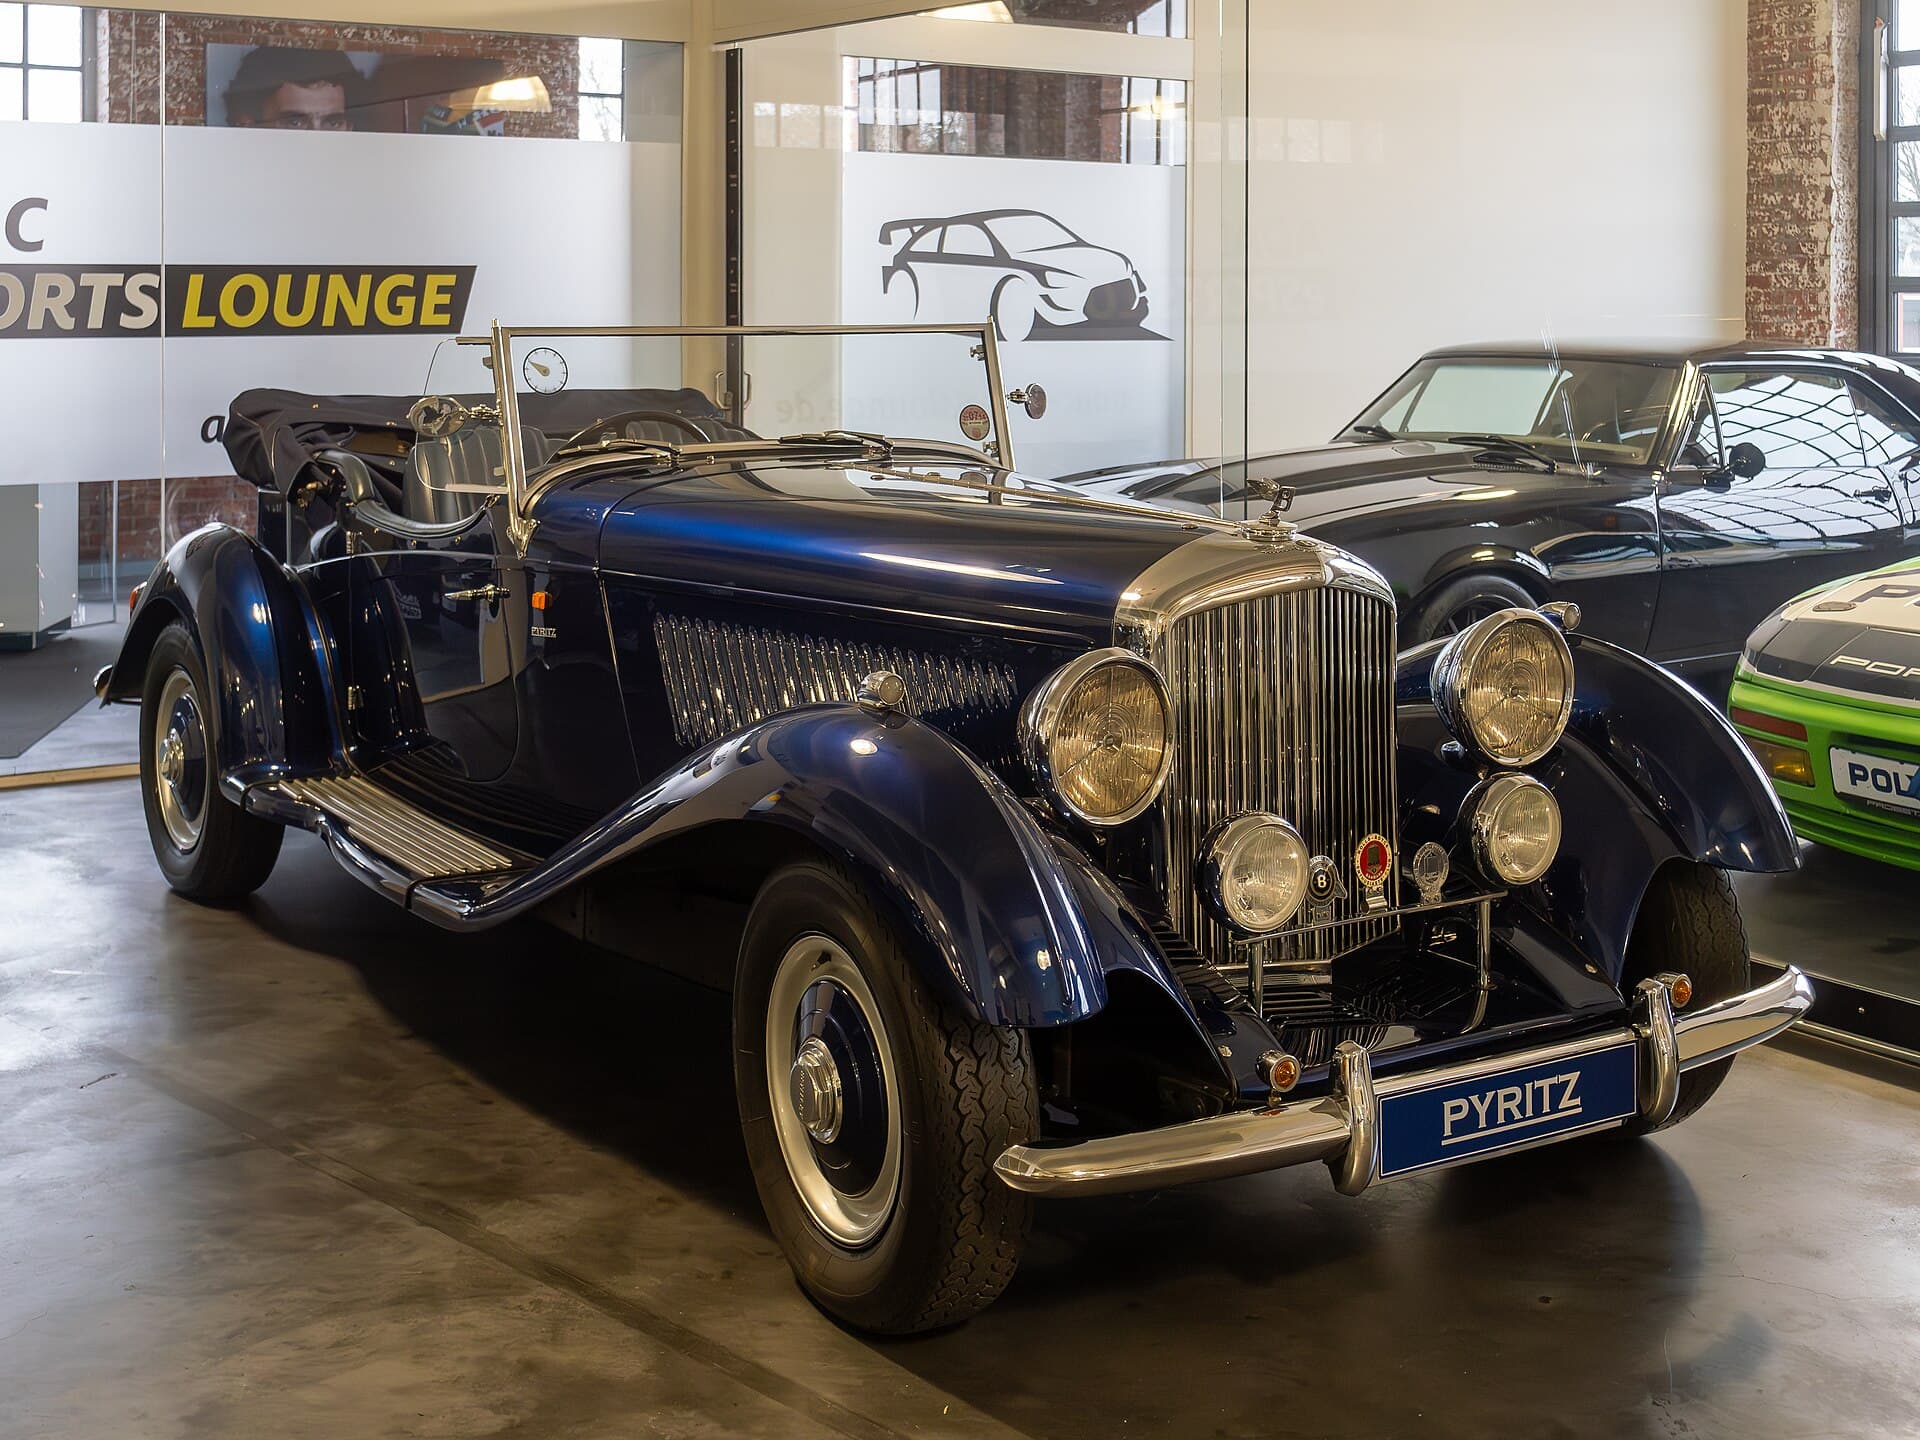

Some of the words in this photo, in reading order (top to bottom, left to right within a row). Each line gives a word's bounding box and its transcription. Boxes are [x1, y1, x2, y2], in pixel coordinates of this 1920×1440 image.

[5, 197, 49, 252] C
[182, 273, 457, 330] LOUNGE
[1317, 874, 1327, 888] B
[1442, 1071, 1583, 1138] PYRITZ
